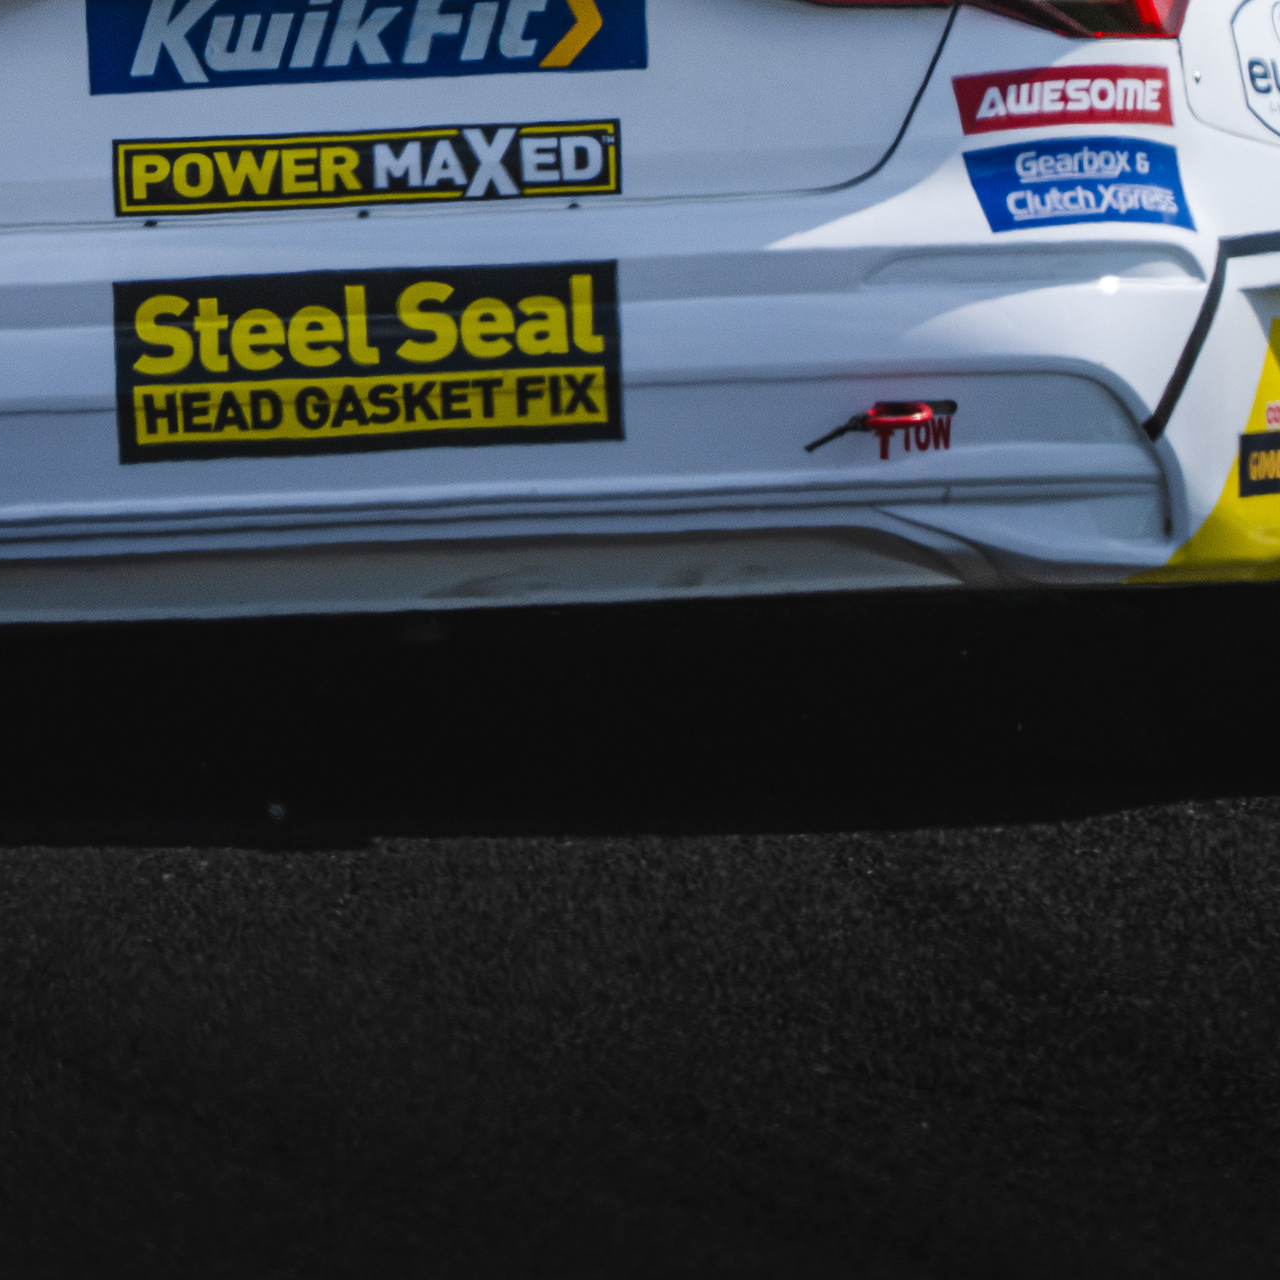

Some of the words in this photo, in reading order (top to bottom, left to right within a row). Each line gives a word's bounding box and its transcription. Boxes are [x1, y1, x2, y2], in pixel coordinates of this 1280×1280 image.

[976, 78, 1163, 121] AWESOME
[131, 145, 363, 200] POWER
[372, 127, 605, 198] MAXED
[1015, 147, 1131, 183] Gearbox
[133, 284, 381, 376] Steel
[396, 273, 605, 364] Seal
[142, 386, 284, 437] HEAD
[294, 375, 507, 430] GASKET
[516, 371, 600, 417] FIX
